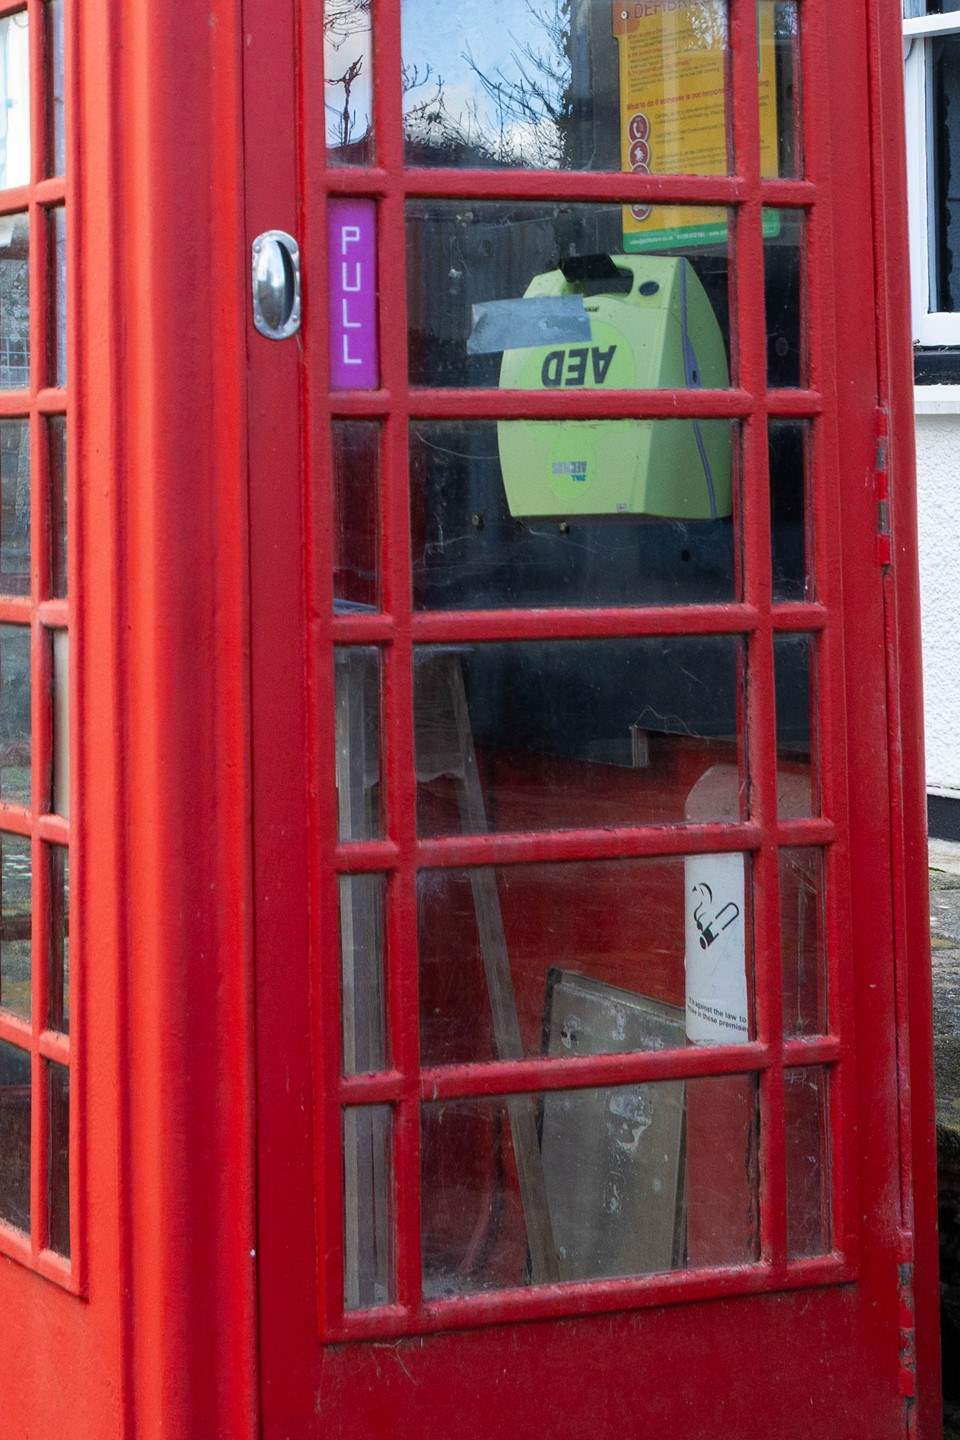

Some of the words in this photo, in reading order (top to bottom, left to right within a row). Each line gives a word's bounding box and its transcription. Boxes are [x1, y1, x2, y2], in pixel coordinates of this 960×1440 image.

[341, 226, 362, 364] PULL
[541, 345, 617, 388] AED
[725, 1012, 737, 1021] law
